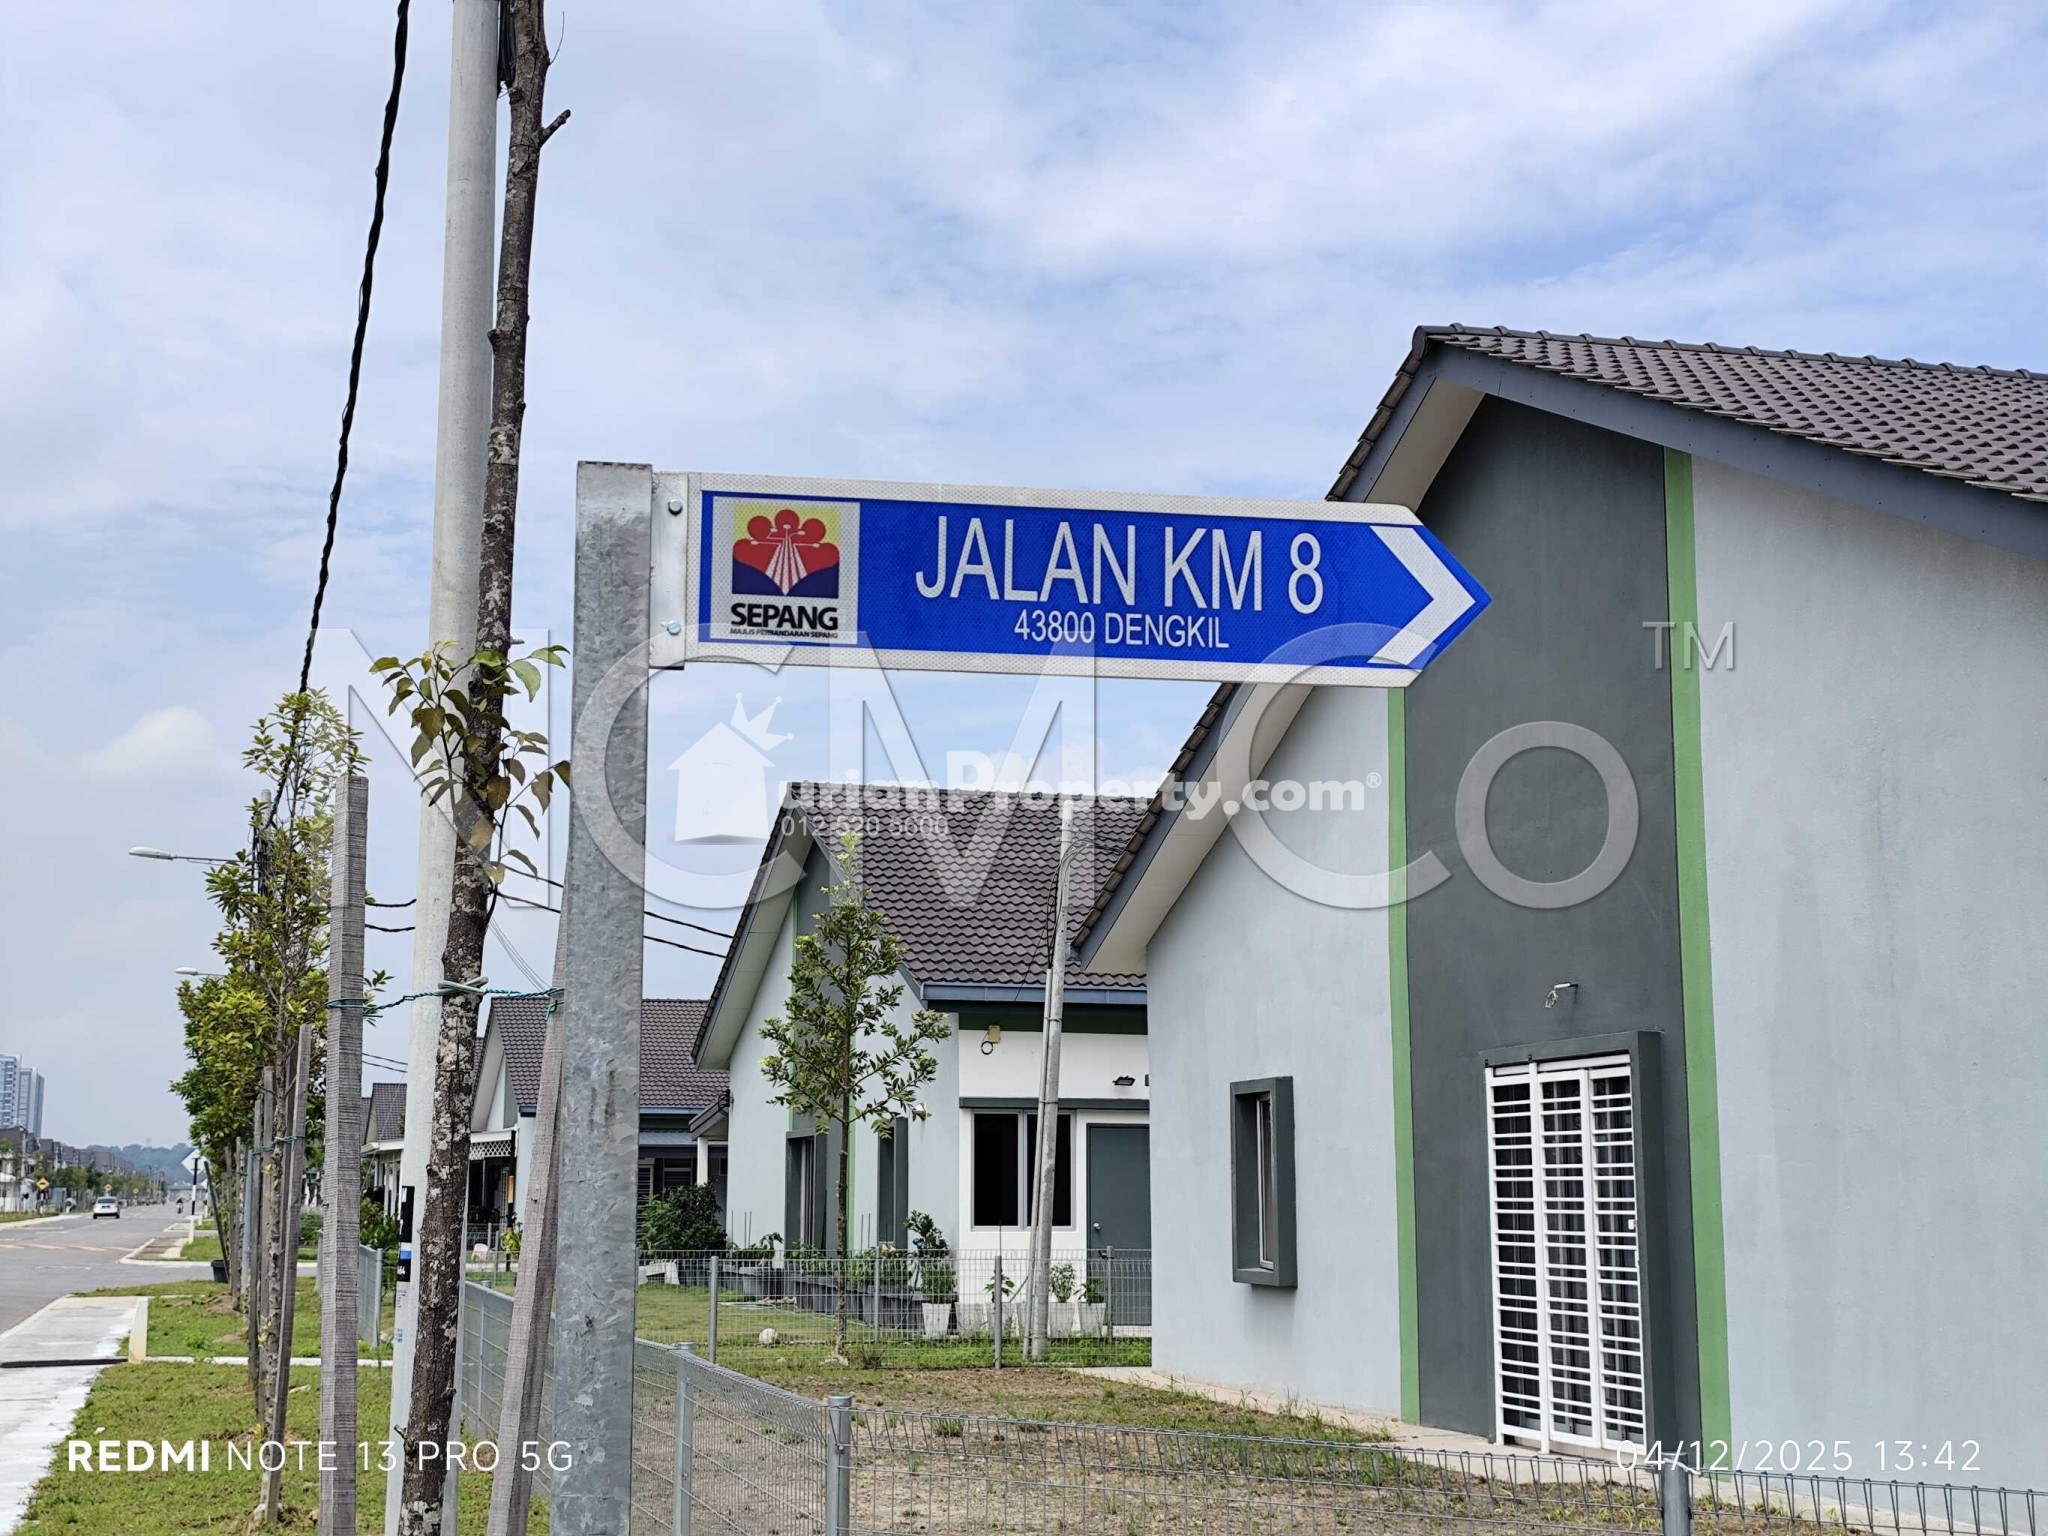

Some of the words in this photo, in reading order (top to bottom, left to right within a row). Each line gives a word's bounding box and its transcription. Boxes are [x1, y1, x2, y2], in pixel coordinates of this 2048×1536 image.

[915, 515, 1136, 606] JALAN
[1164, 526, 1263, 612] KM
[1288, 532, 1324, 614] 8
[730, 602, 839, 631] SEPANG
[730, 627, 755, 636] MAJLIS
[756, 628, 810, 638] PERBANDARAN
[810, 631, 839, 639] SEPANG
[1014, 609, 1096, 644] 43800
[1104, 612, 1230, 649] DENGKIL
